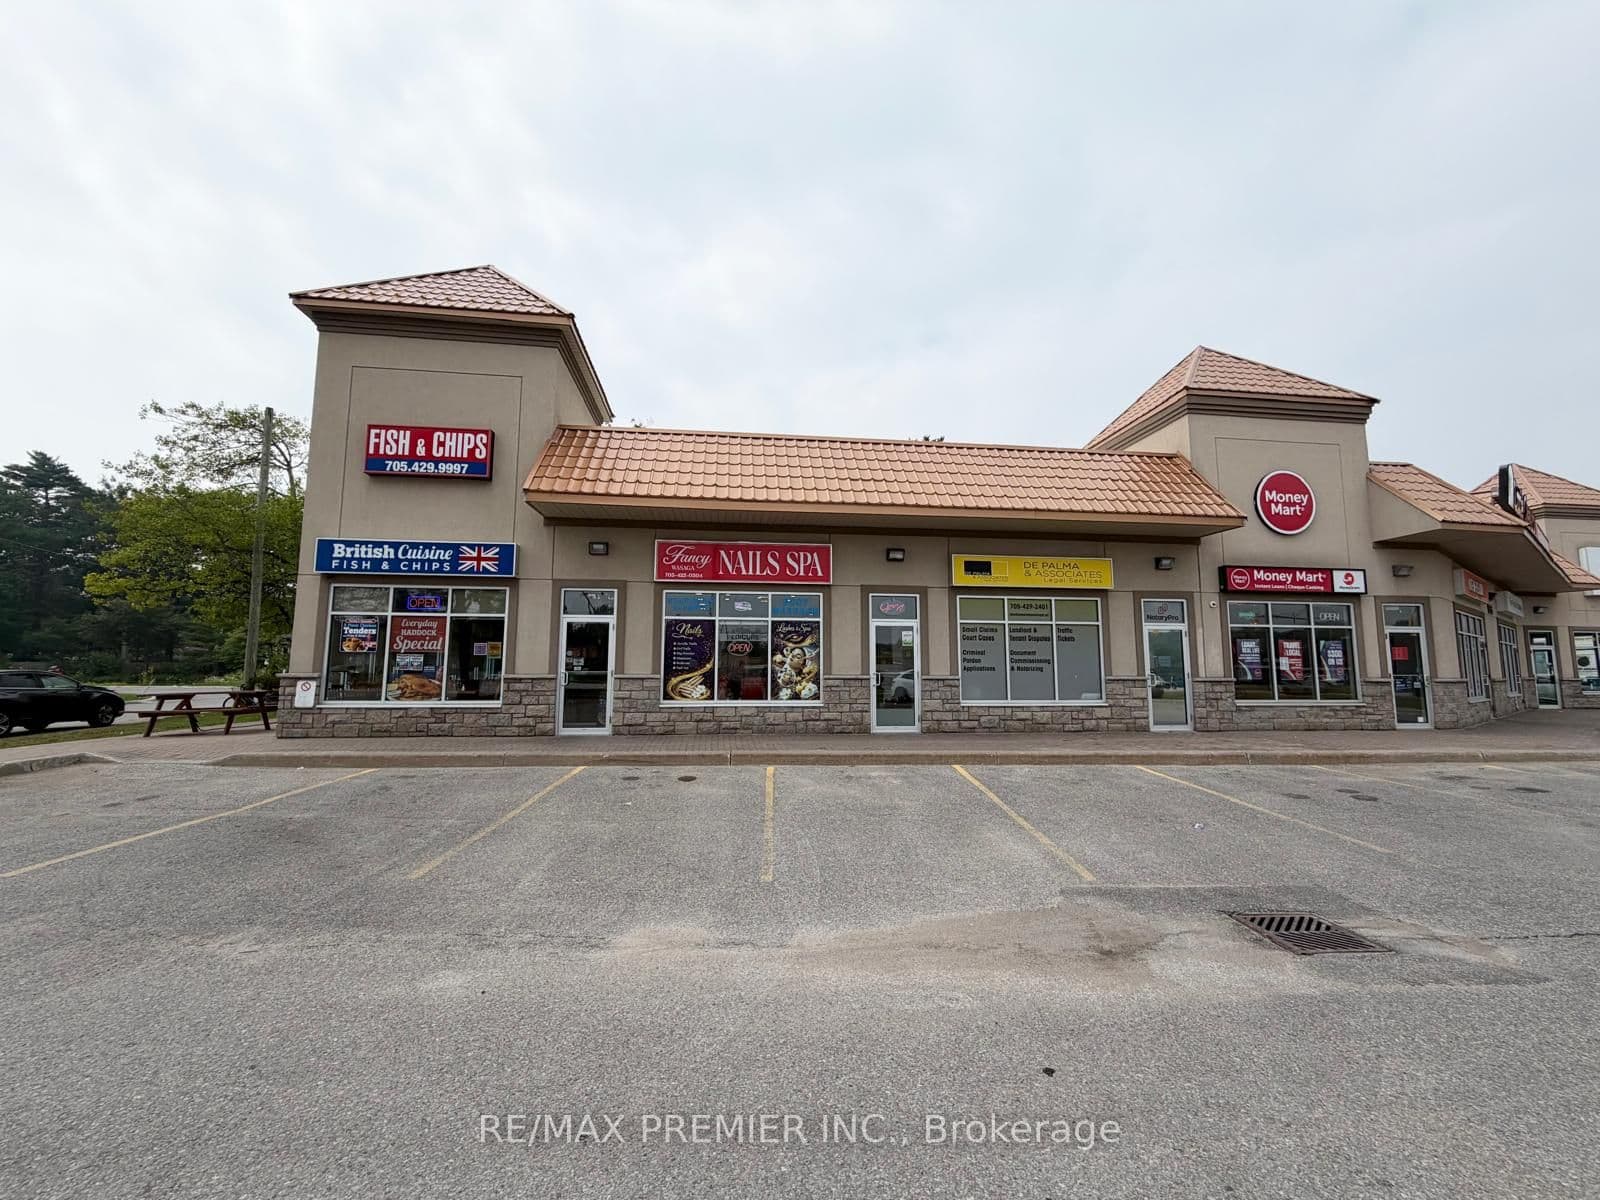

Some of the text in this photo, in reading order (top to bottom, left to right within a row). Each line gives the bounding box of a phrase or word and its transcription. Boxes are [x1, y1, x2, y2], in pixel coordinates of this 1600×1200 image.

[368, 429, 488, 459] FISH & CHIPS
[385, 460, 469, 474] 705.429.9997
[1264, 489, 1309, 505] Money
[1271, 502, 1304, 516] Mart
[332, 543, 454, 561] British Cuisine
[331, 559, 451, 571] FISH & CHIPS
[663, 544, 824, 577] Fancy NAILS SPA
[1023, 561, 1080, 570] DE PALMA
[1024, 569, 1104, 579] & ASSOCIATES
[1253, 569, 1326, 584] Money Mart
[409, 598, 438, 608] OPEN
[1146, 614, 1179, 622] NotaryPro
[1319, 612, 1340, 621] OPEN
[401, 618, 438, 629] Everyday
[343, 626, 377, 635] Tenders
[400, 628, 437, 637] HADDOCK
[393, 635, 444, 653] Special
[728, 643, 751, 652] OPEN
